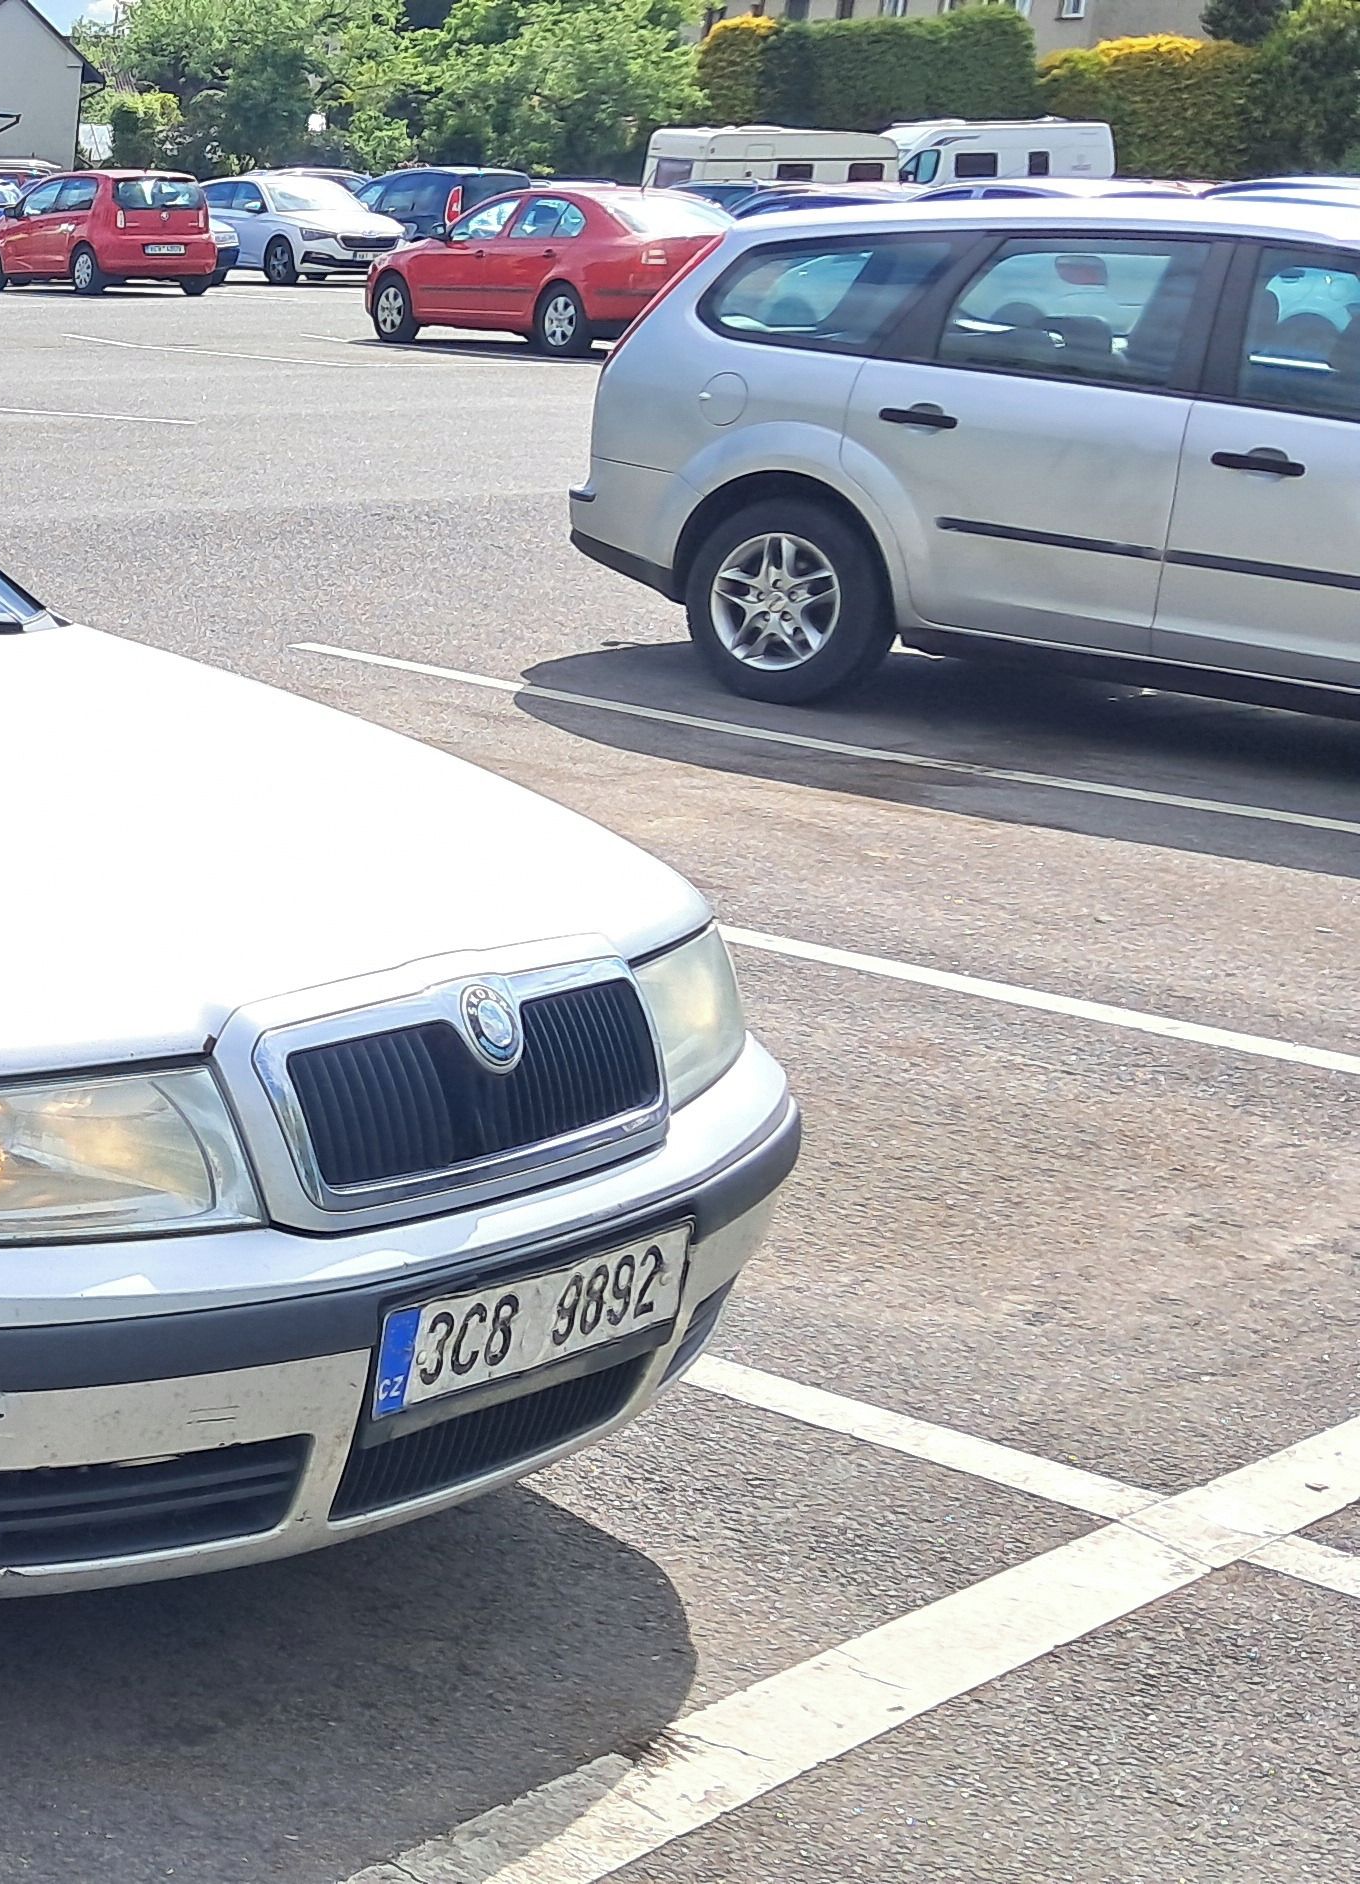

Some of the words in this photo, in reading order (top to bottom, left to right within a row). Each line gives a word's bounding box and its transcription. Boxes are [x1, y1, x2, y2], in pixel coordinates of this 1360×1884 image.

[420, 1293, 520, 1386] 3C8
[552, 1244, 666, 1347] 9892
[378, 1374, 402, 1401] CZ
